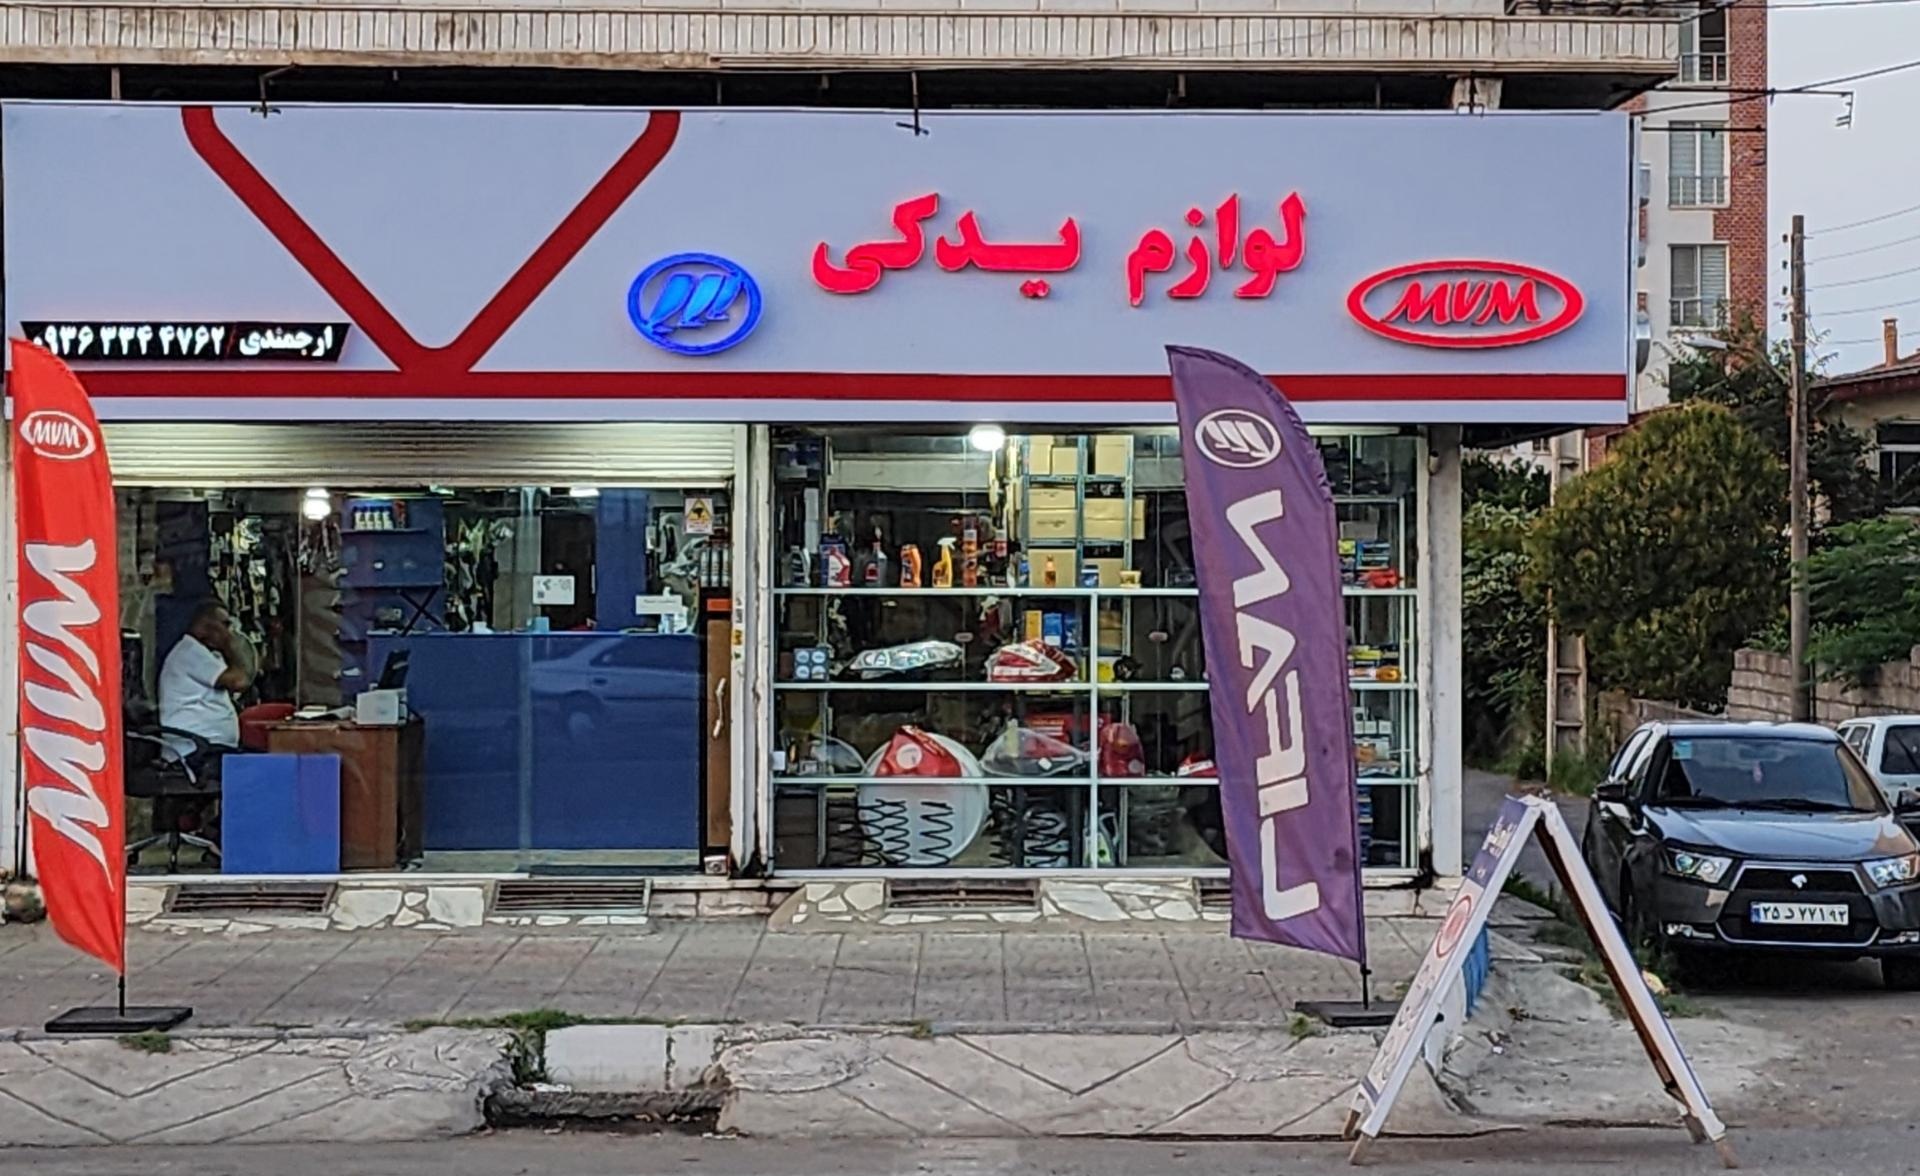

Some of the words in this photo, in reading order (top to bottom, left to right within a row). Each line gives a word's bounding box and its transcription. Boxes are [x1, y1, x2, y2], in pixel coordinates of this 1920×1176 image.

[812, 192, 1082, 298] یدکی
[1127, 191, 1306, 308] لوازم
[1380, 279, 1542, 325] MVM
[100, 325, 153, 355] ۳۳۴
[158, 325, 225, 355] ۴۷۶۲
[239, 325, 333, 357] ارجمندی
[33, 420, 81, 448] MVM
[23, 538, 114, 892] MVM
[1226, 489, 1320, 921] LIFAN
